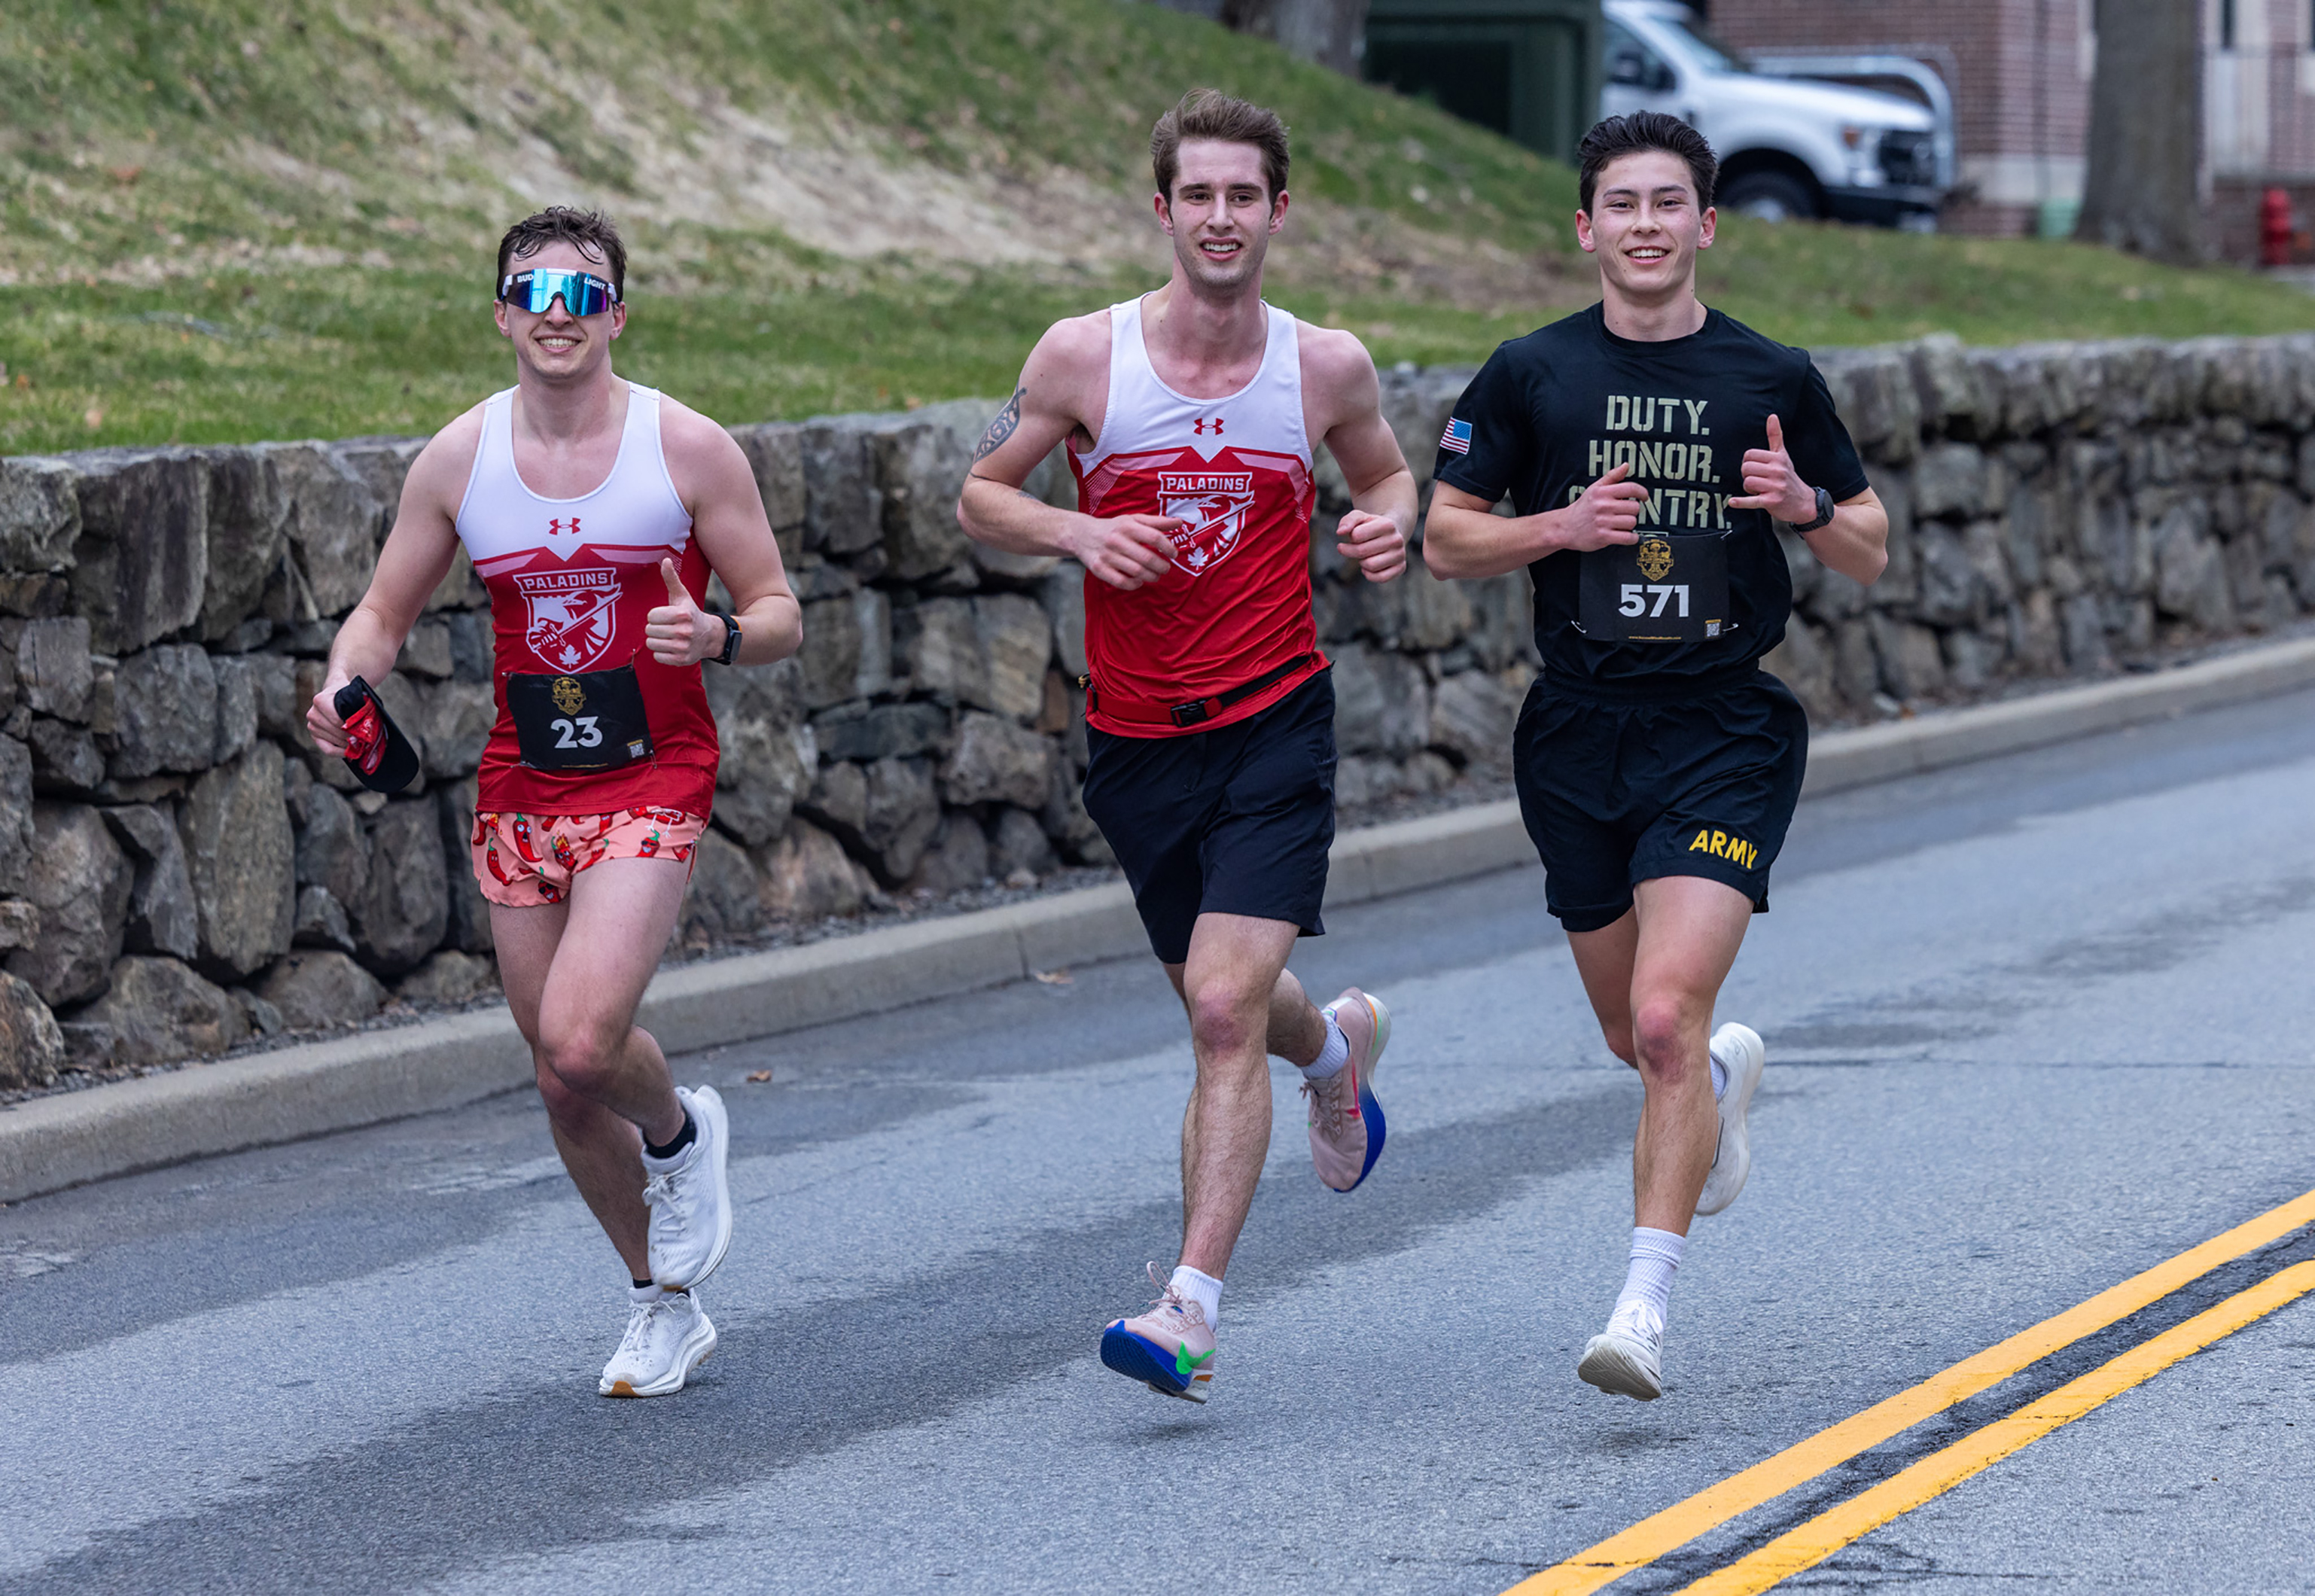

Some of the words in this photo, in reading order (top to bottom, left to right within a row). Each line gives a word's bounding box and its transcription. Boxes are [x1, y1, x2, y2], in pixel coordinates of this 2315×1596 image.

[516, 273, 535, 284] BUD
[583, 277, 607, 290] LIGHT
[1606, 395, 1710, 435] DUTY.
[1588, 440, 1720, 483] HONOR.
[1166, 477, 1244, 491] PALADINS
[1569, 486, 1733, 529] NTRY.
[522, 571, 608, 590] PALADINS
[1618, 583, 1689, 617] 571
[550, 716, 603, 749] 23
[1689, 829, 1758, 870] ARMY
